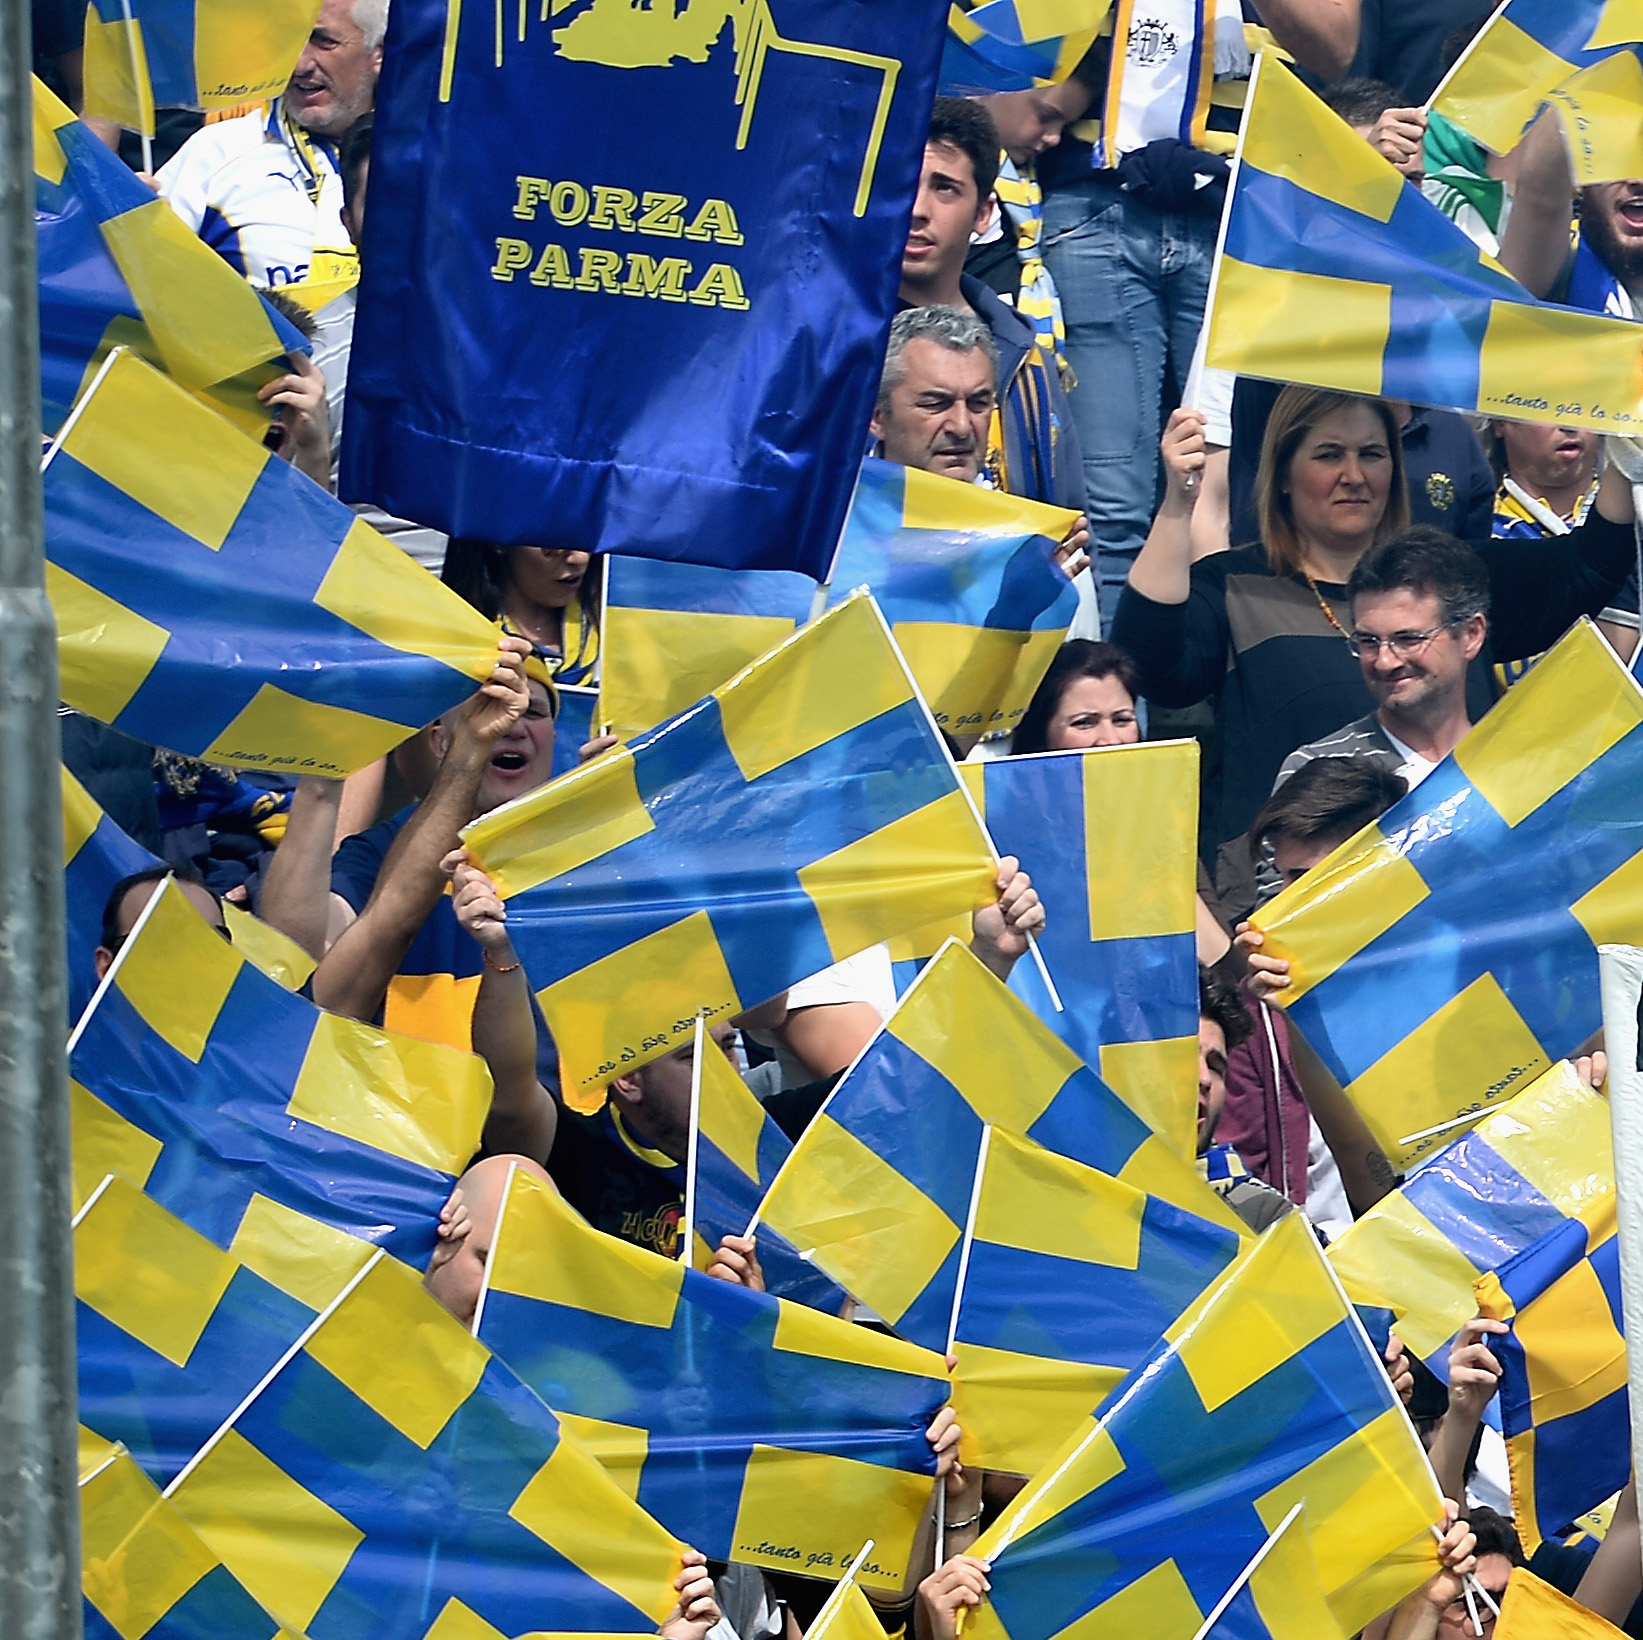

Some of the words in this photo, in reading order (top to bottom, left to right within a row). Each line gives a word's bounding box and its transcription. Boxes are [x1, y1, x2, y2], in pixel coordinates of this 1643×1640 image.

[513, 174, 745, 247] FORZA
[490, 236, 751, 312] PARMA
[1486, 392, 1549, 411] ...tanto
[1555, 402, 1583, 418] già
[1590, 404, 1606, 420] lo
[739, 1540, 802, 1560] ...tanto
[807, 1551, 835, 1568] già
[860, 1559, 899, 1578] so...
